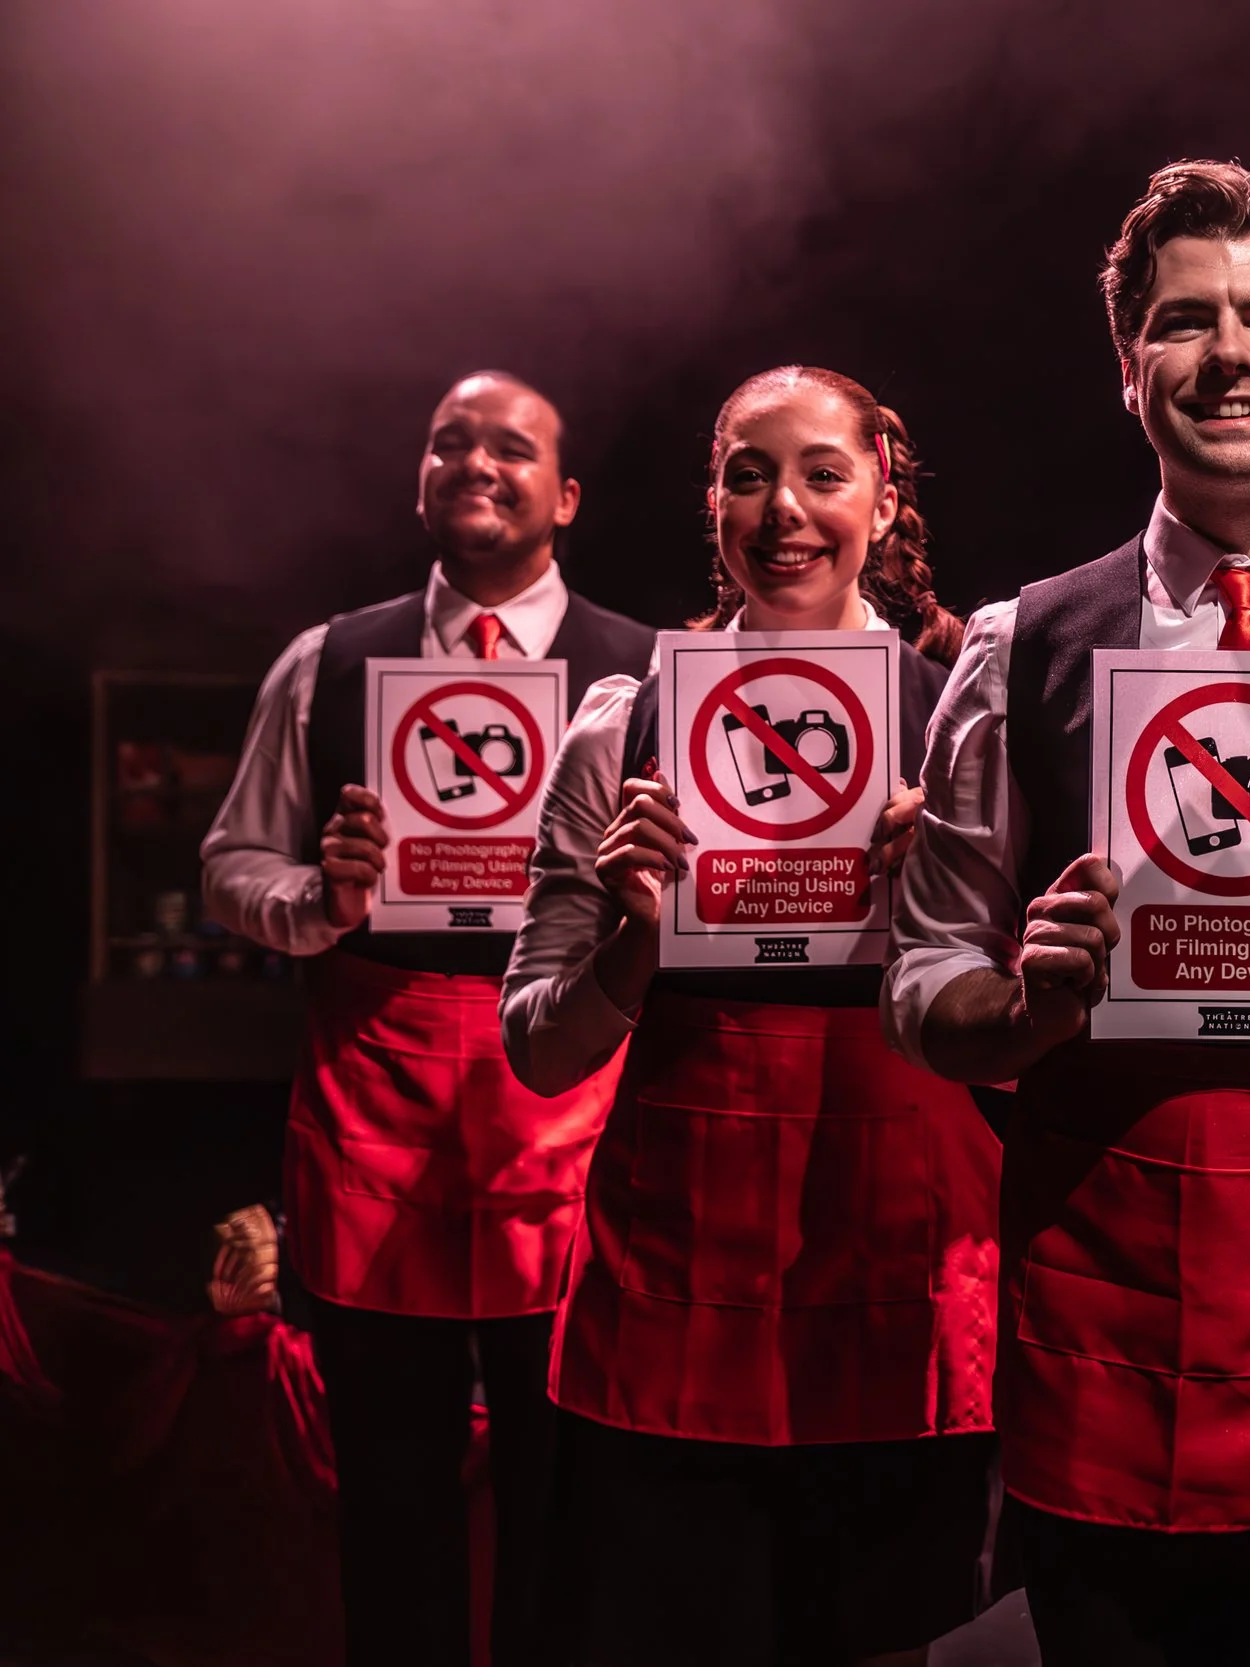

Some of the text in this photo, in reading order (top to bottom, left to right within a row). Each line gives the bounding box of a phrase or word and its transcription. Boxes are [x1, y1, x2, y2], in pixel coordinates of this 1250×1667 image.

[410, 843, 530, 858] No Photography
[410, 861, 426, 873] or
[430, 859, 485, 875] Filming
[712, 856, 854, 875] No Photography
[431, 875, 513, 891] Any Device
[711, 877, 855, 896] or Filming Using
[735, 899, 833, 917] Any Device
[1150, 914, 1177, 931] No
[1149, 942, 1169, 955] or
[1176, 939, 1249, 960] Filming
[1175, 963, 1214, 983] Any
